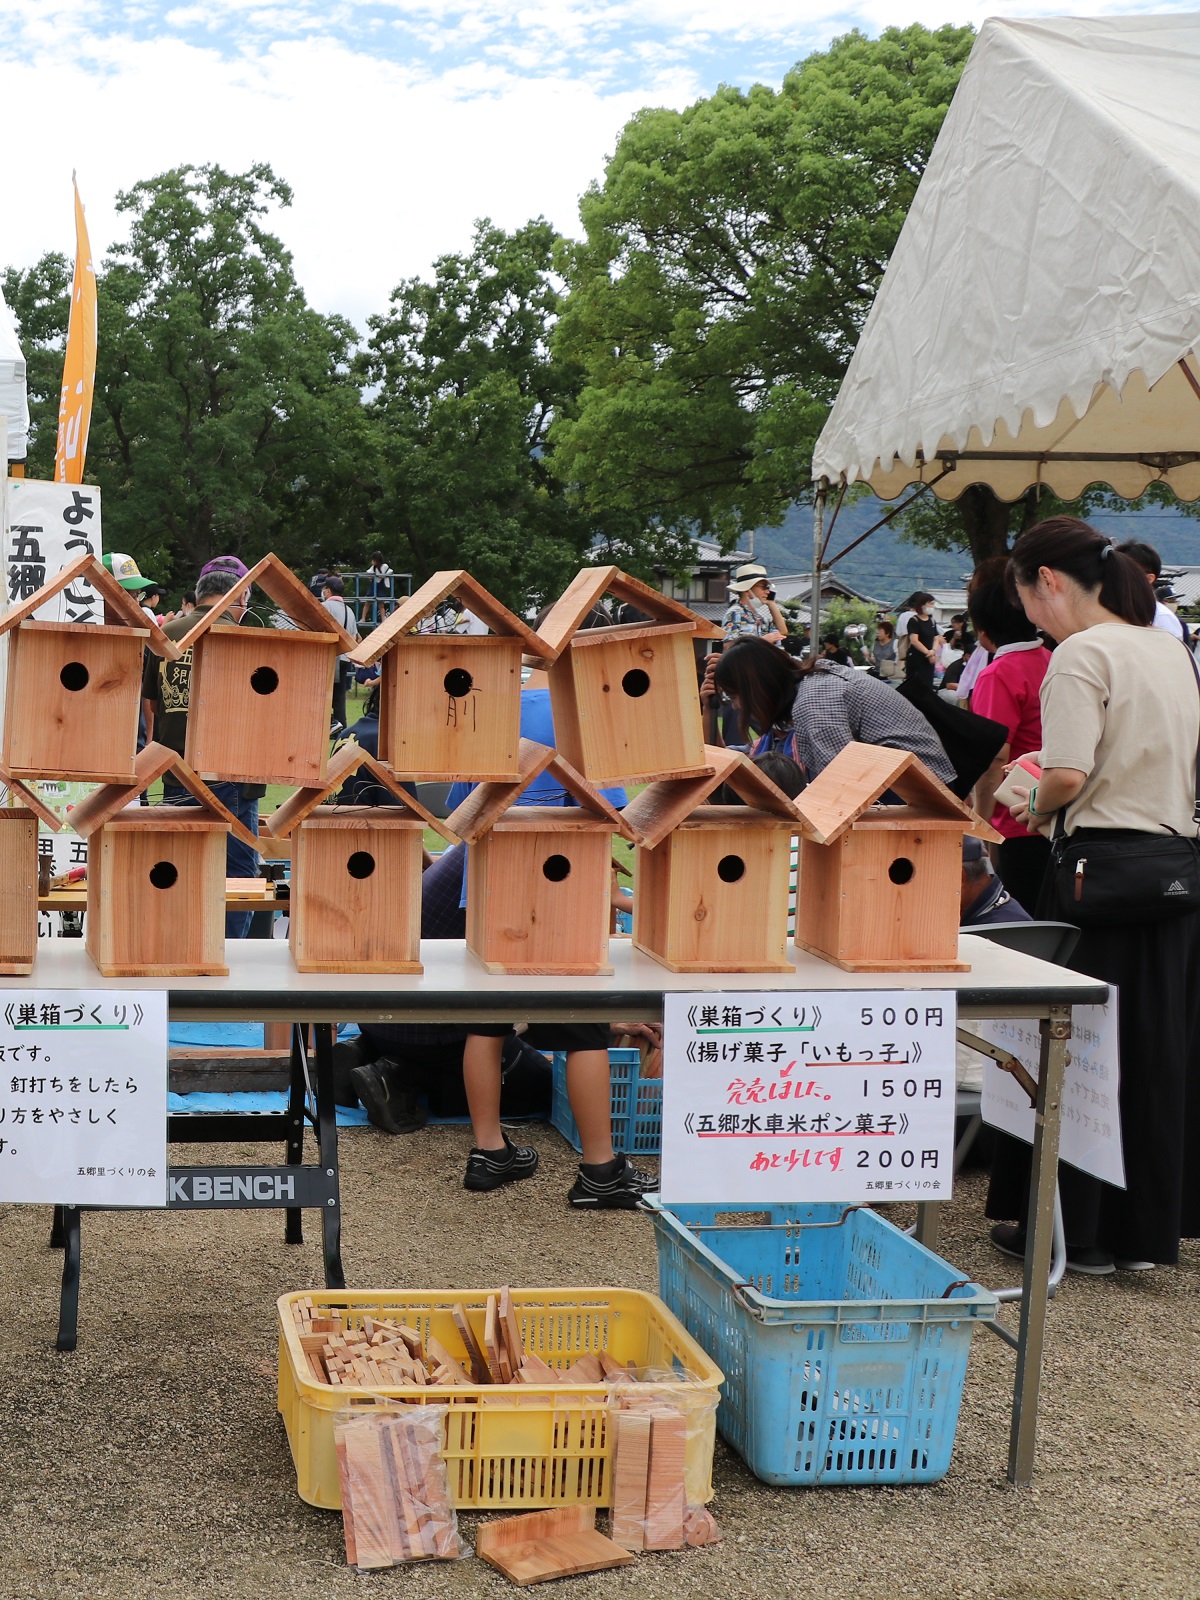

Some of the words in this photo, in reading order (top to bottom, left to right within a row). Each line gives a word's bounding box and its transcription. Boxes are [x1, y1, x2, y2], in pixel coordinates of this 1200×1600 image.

[77, 1167, 156, 1178] 五郷里づくりの会
[865, 1180, 941, 1190] 五郷里づくりの会
